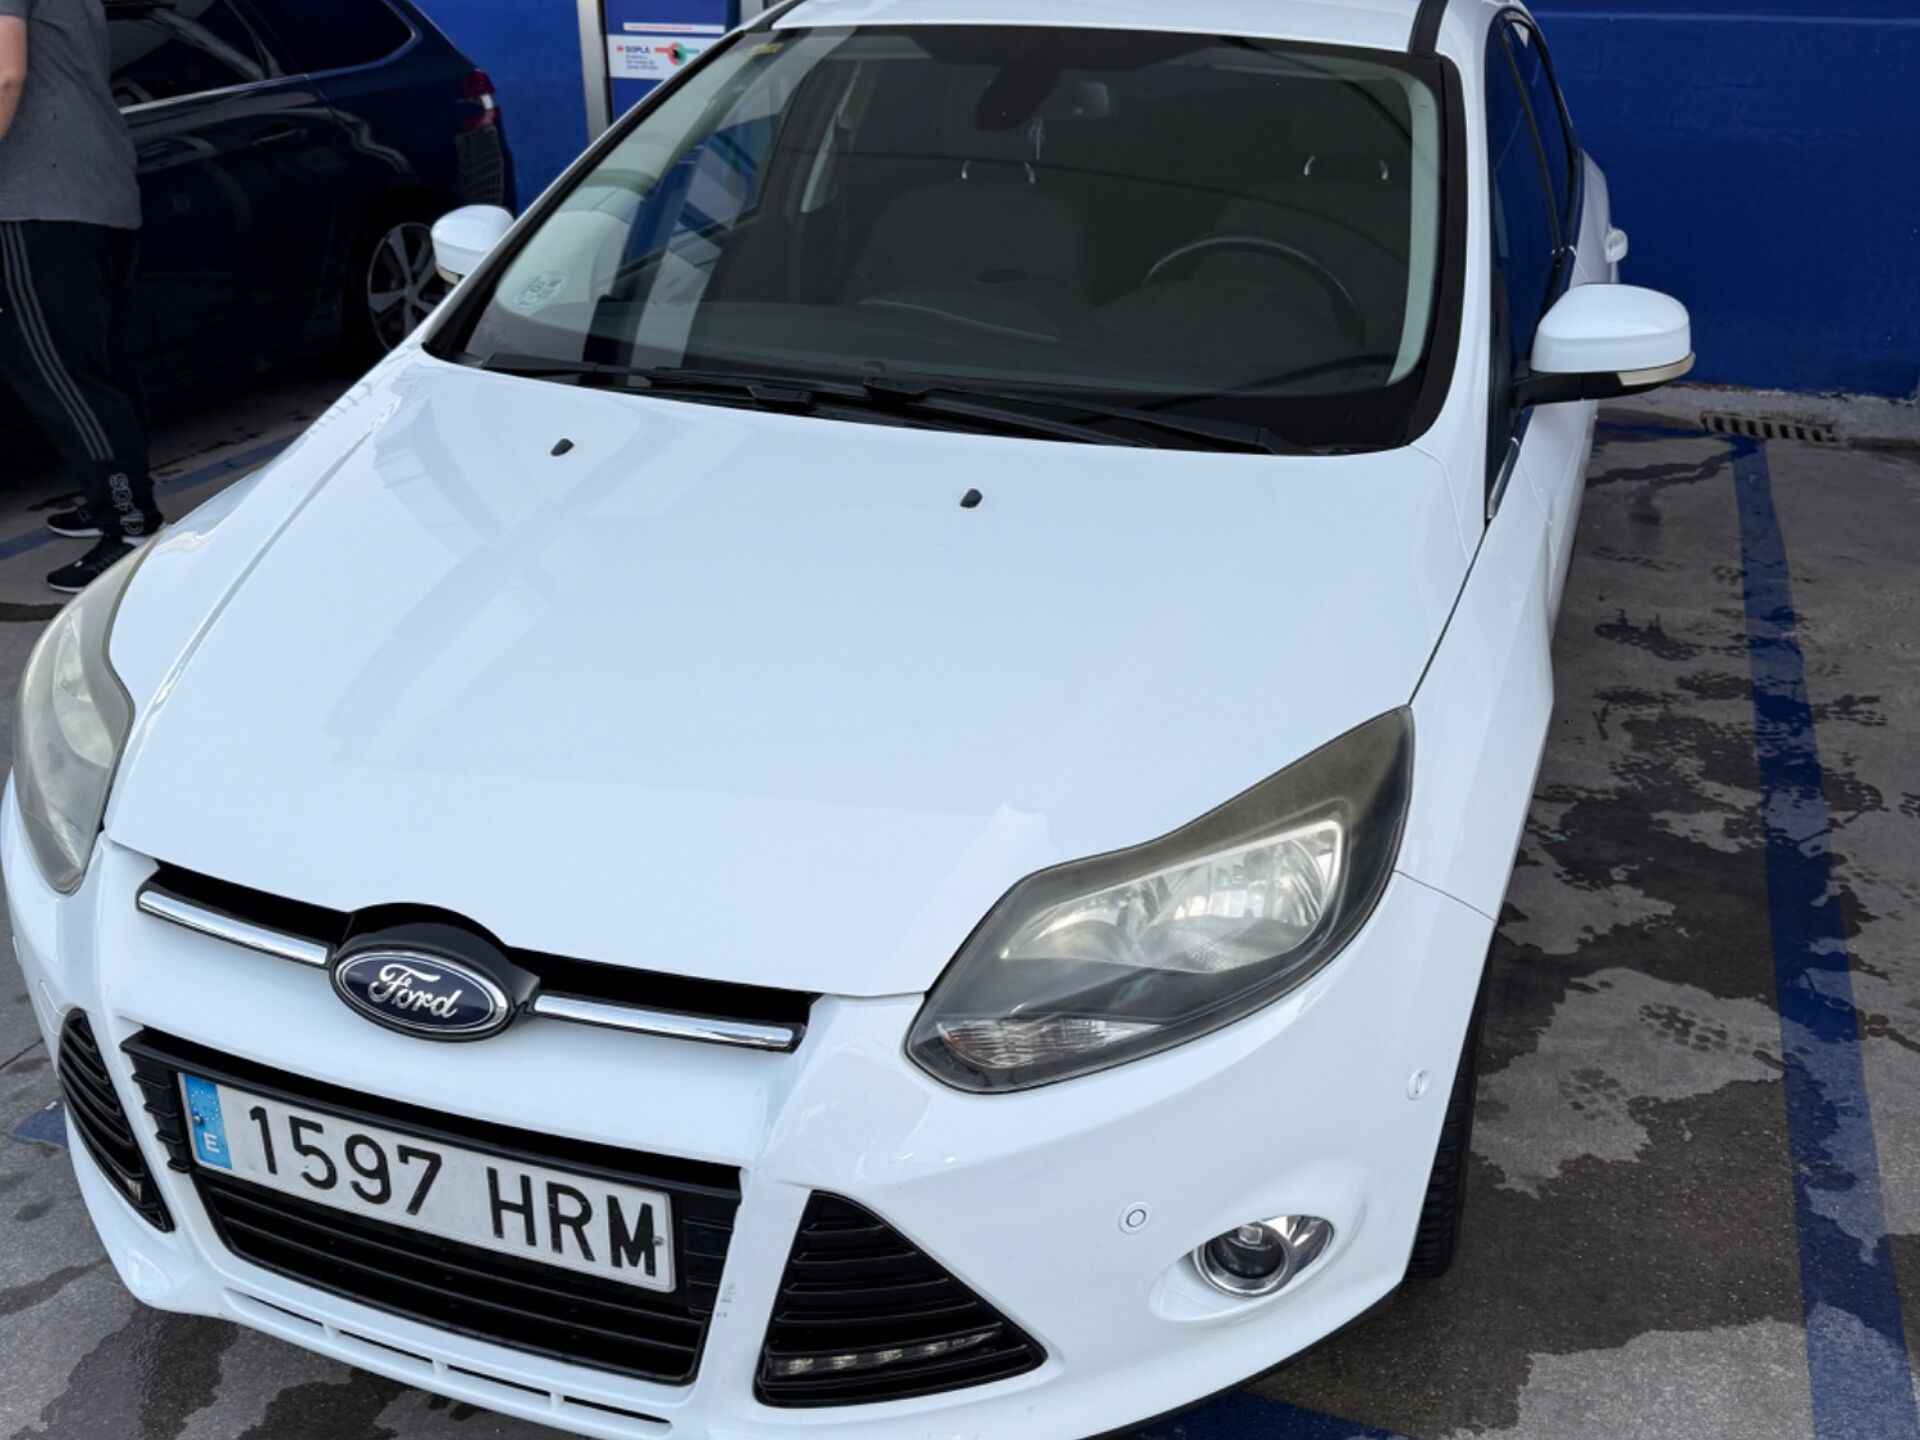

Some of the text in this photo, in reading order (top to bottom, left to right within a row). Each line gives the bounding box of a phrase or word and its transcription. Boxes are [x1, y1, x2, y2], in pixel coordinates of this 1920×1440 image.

[625, 45, 650, 54] SOPLA
[368, 963, 462, 1018] Ford
[203, 1132, 220, 1153] E
[249, 1106, 657, 1277] 1597 HRM
